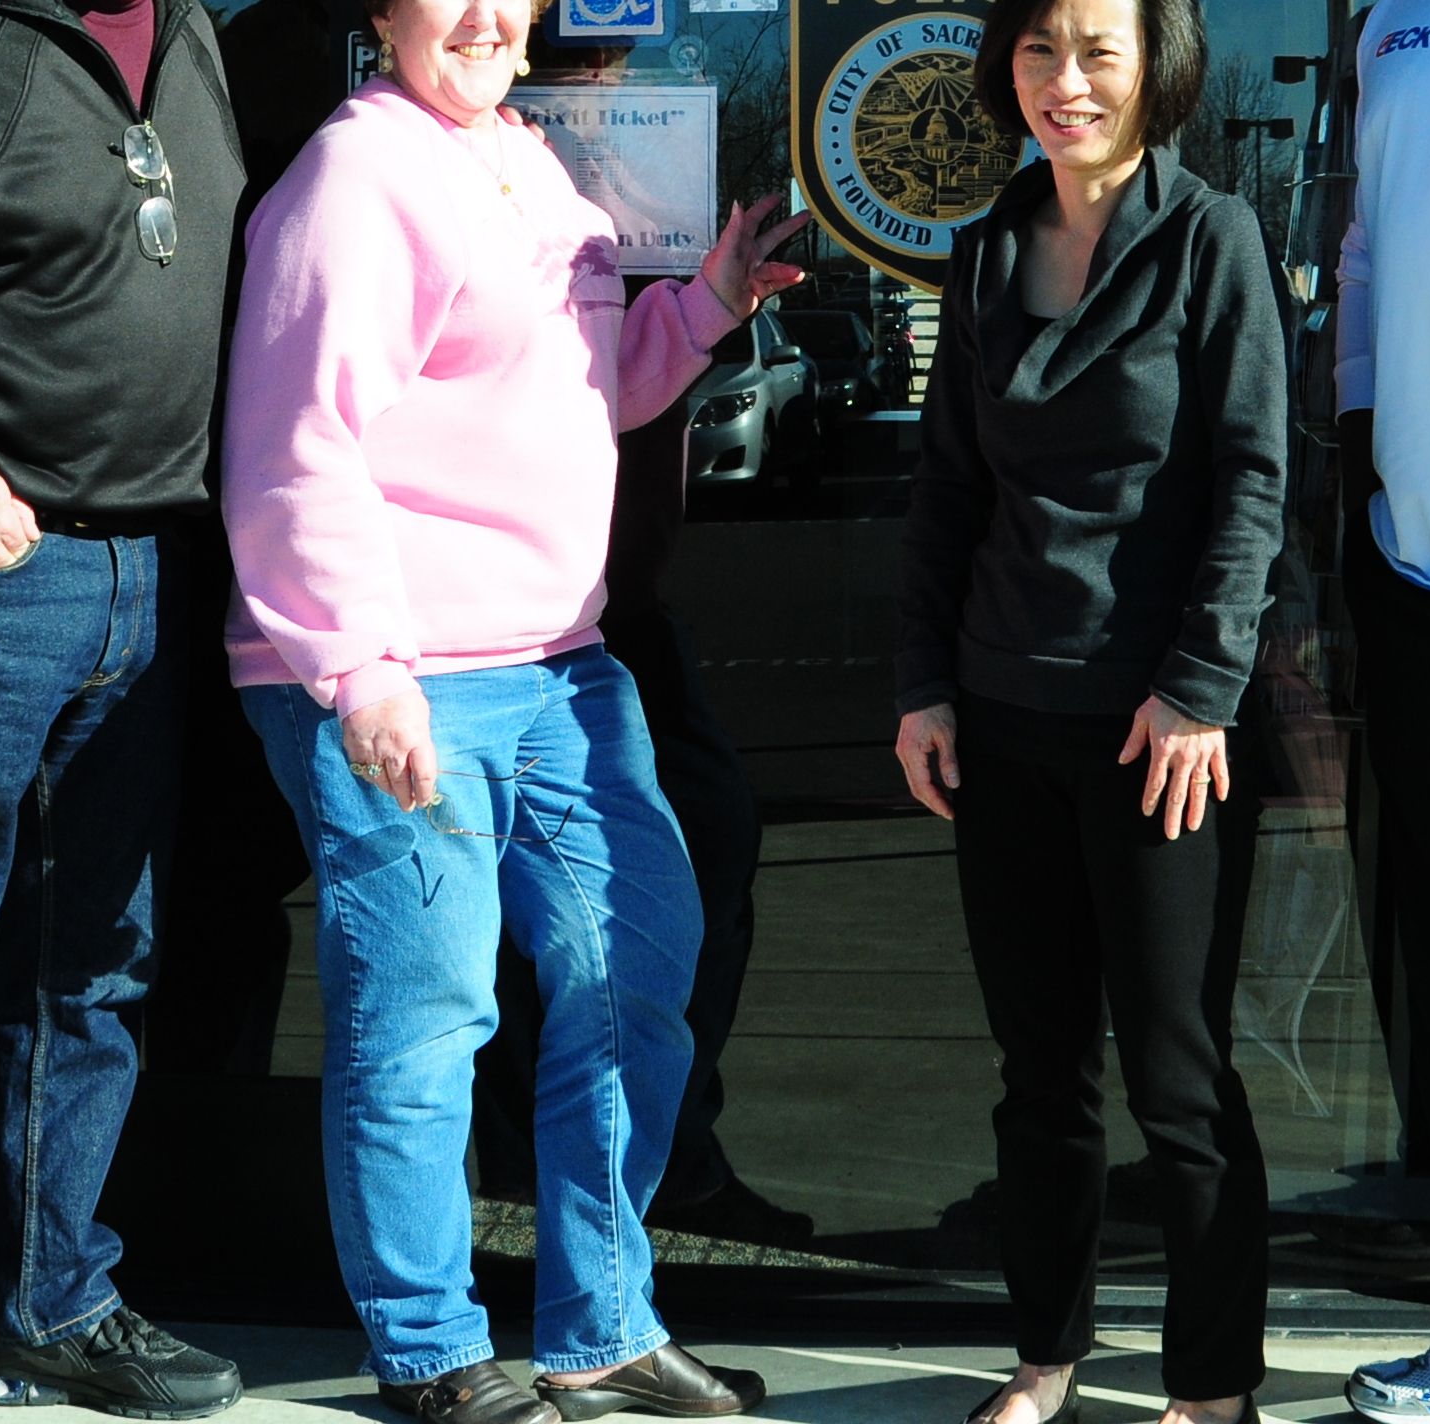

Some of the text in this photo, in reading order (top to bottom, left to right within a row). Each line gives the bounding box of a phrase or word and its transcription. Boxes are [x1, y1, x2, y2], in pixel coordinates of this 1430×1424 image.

[828, 29, 906, 117] CITY OF
[640, 231, 695, 247] Duty
[836, 172, 933, 247] FOUNDED
